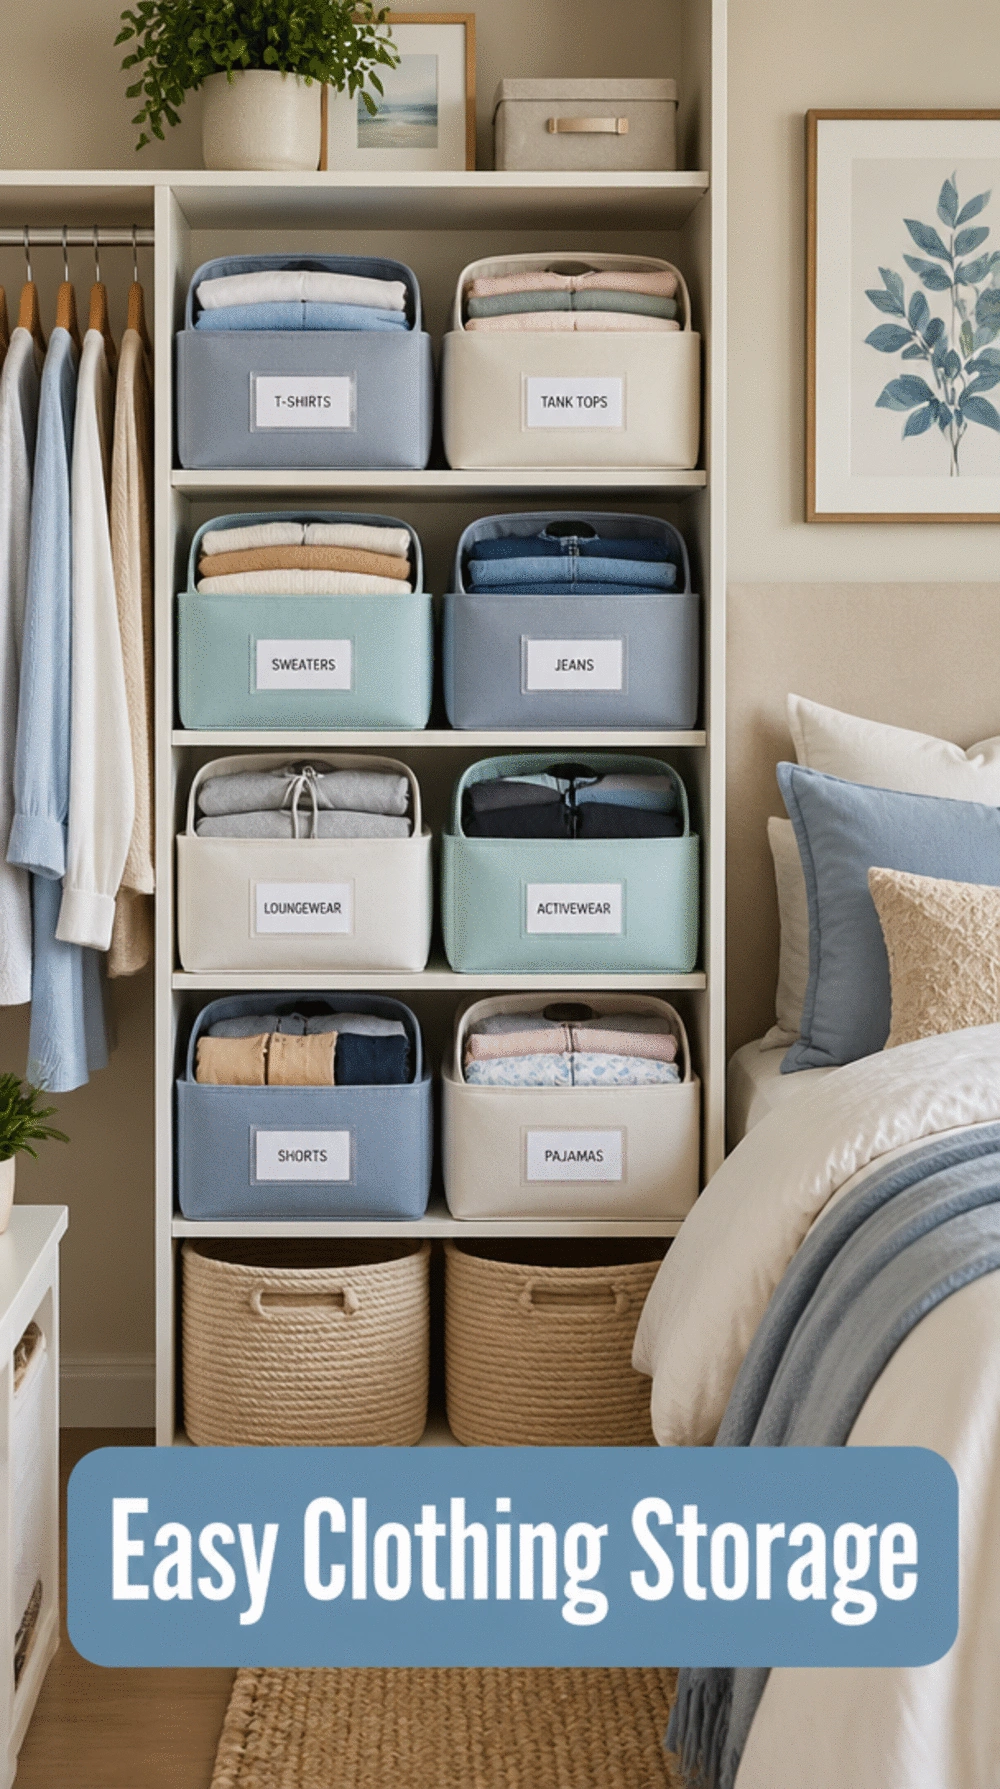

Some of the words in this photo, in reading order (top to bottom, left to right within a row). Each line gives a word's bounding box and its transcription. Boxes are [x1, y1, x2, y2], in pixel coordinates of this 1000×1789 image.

[274, 395, 331, 409] T-SHIRTS
[541, 395, 573, 409] TANK
[576, 395, 608, 409] TOPS
[271, 658, 336, 672] SWEATERS
[555, 658, 595, 672] JEANS
[264, 902, 342, 915] LOUNGEWEAR
[537, 902, 611, 915] ACTIVEWEAR
[277, 1149, 328, 1162] SHORTS
[544, 1149, 604, 1163] PAJAMAS
